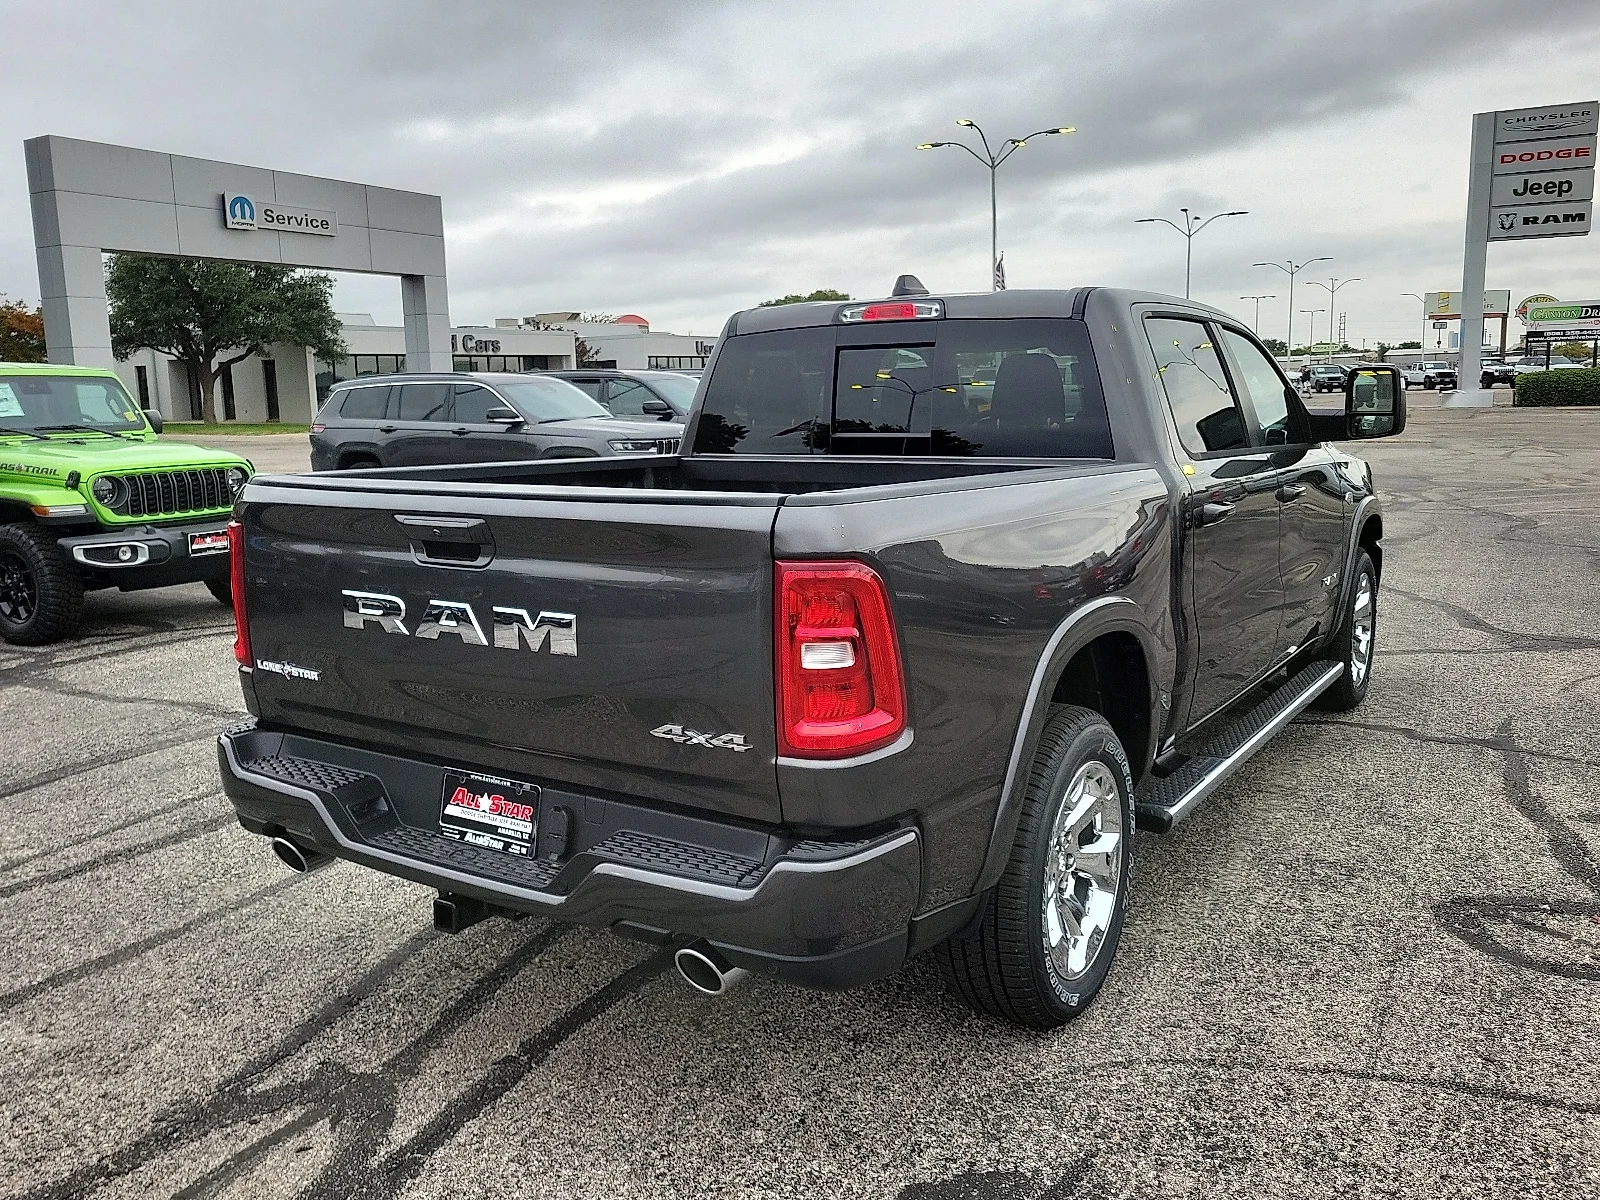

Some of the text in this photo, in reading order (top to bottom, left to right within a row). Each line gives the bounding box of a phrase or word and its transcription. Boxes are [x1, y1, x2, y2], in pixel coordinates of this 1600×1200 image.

[1504, 110, 1591, 125] CHRYSLER
[1500, 147, 1591, 164] DODGE
[1512, 178, 1573, 197] Jeep
[263, 208, 330, 230] Service
[1522, 212, 1586, 226] RAM
[1533, 307, 1600, 319] CANYON DR
[462, 334, 501, 353] Cars
[24, 465, 60, 476] TRAIL
[342, 589, 577, 657] RAM
[256, 659, 320, 681] LONE STAR
